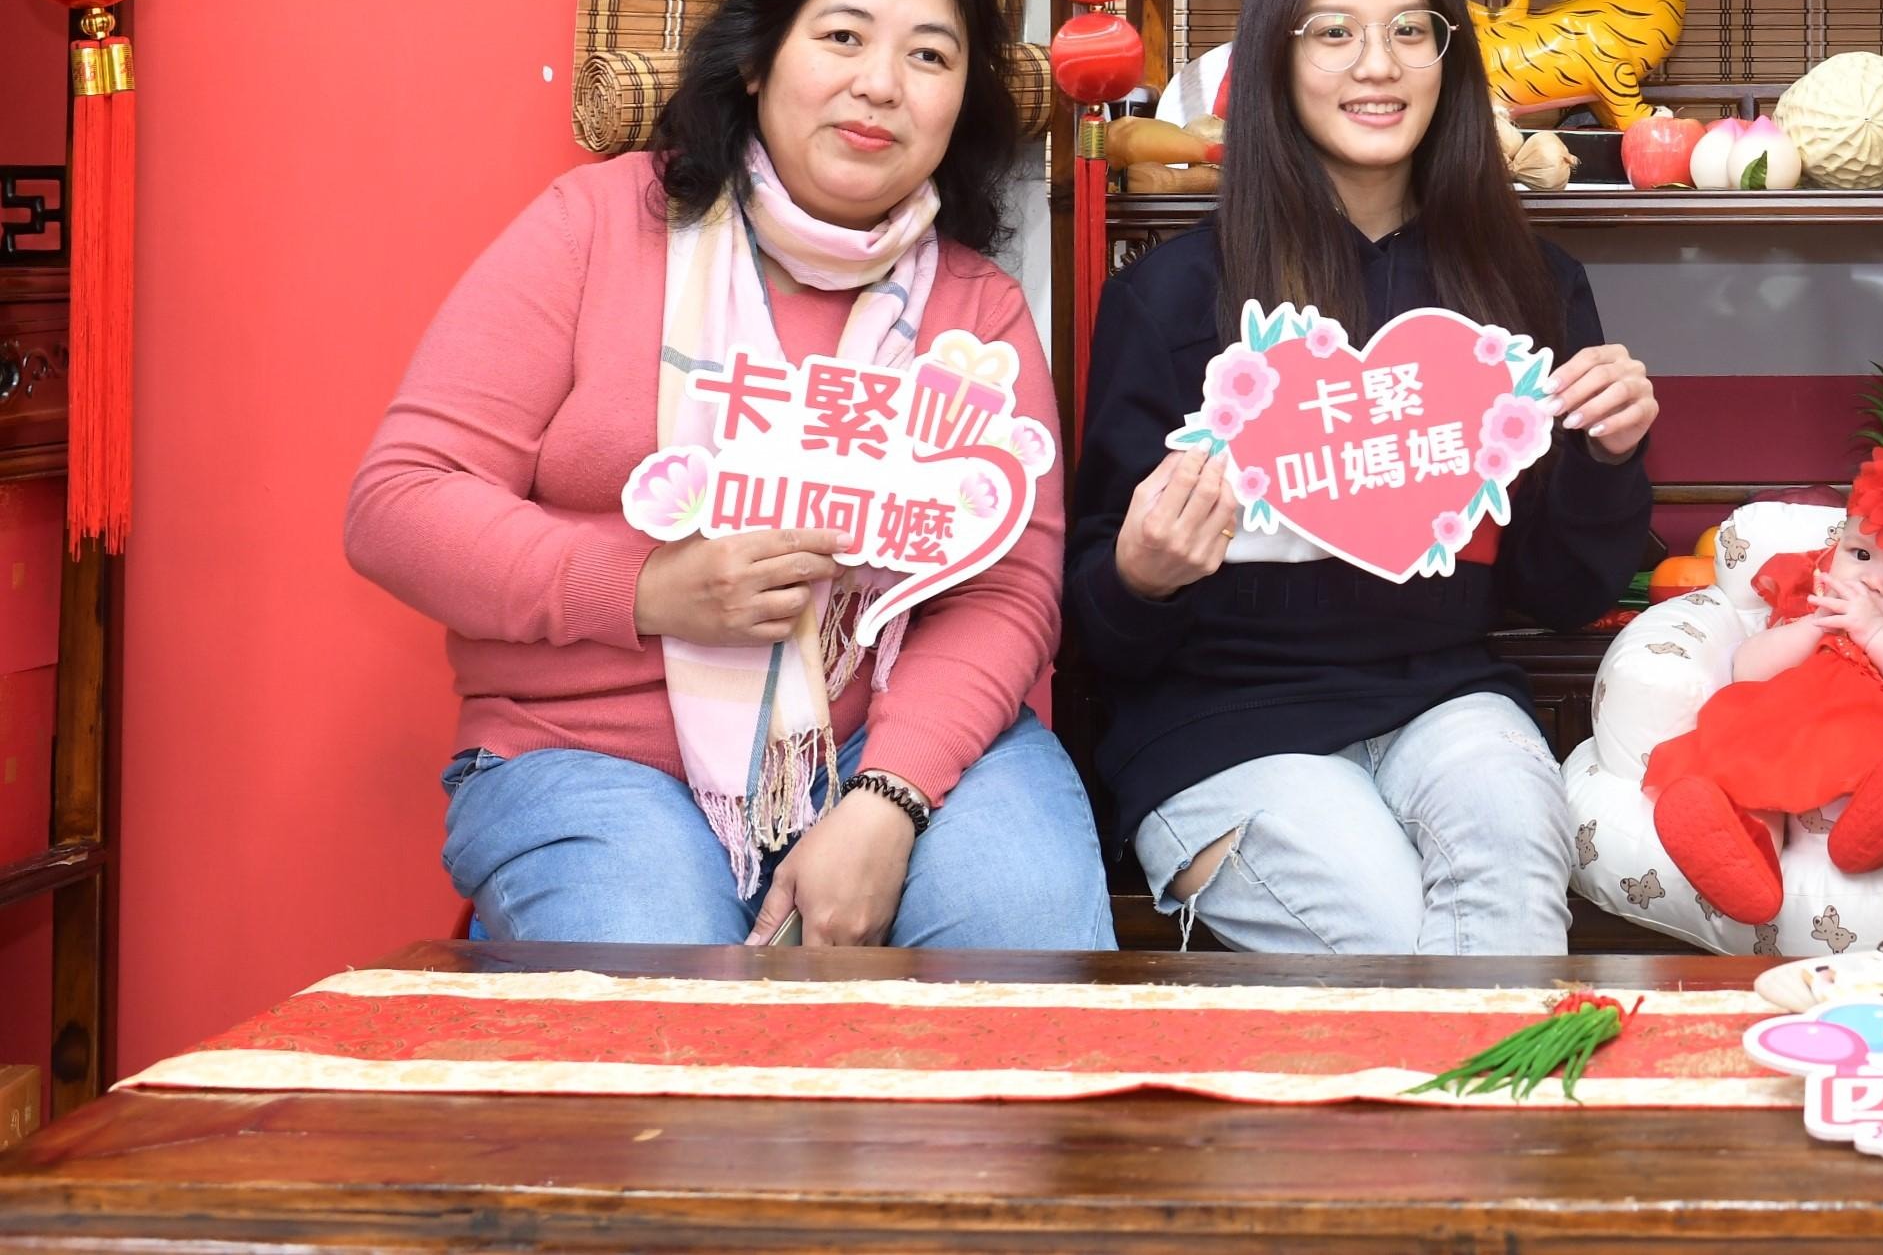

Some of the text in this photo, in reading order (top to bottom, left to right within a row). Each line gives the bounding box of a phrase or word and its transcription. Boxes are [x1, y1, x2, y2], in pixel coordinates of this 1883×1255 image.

[694, 352, 901, 460] 卡緊
[1297, 361, 1426, 434] 卡緊
[1275, 421, 1471, 504] 叫媽媽
[709, 470, 957, 567] 叫阿嬤
